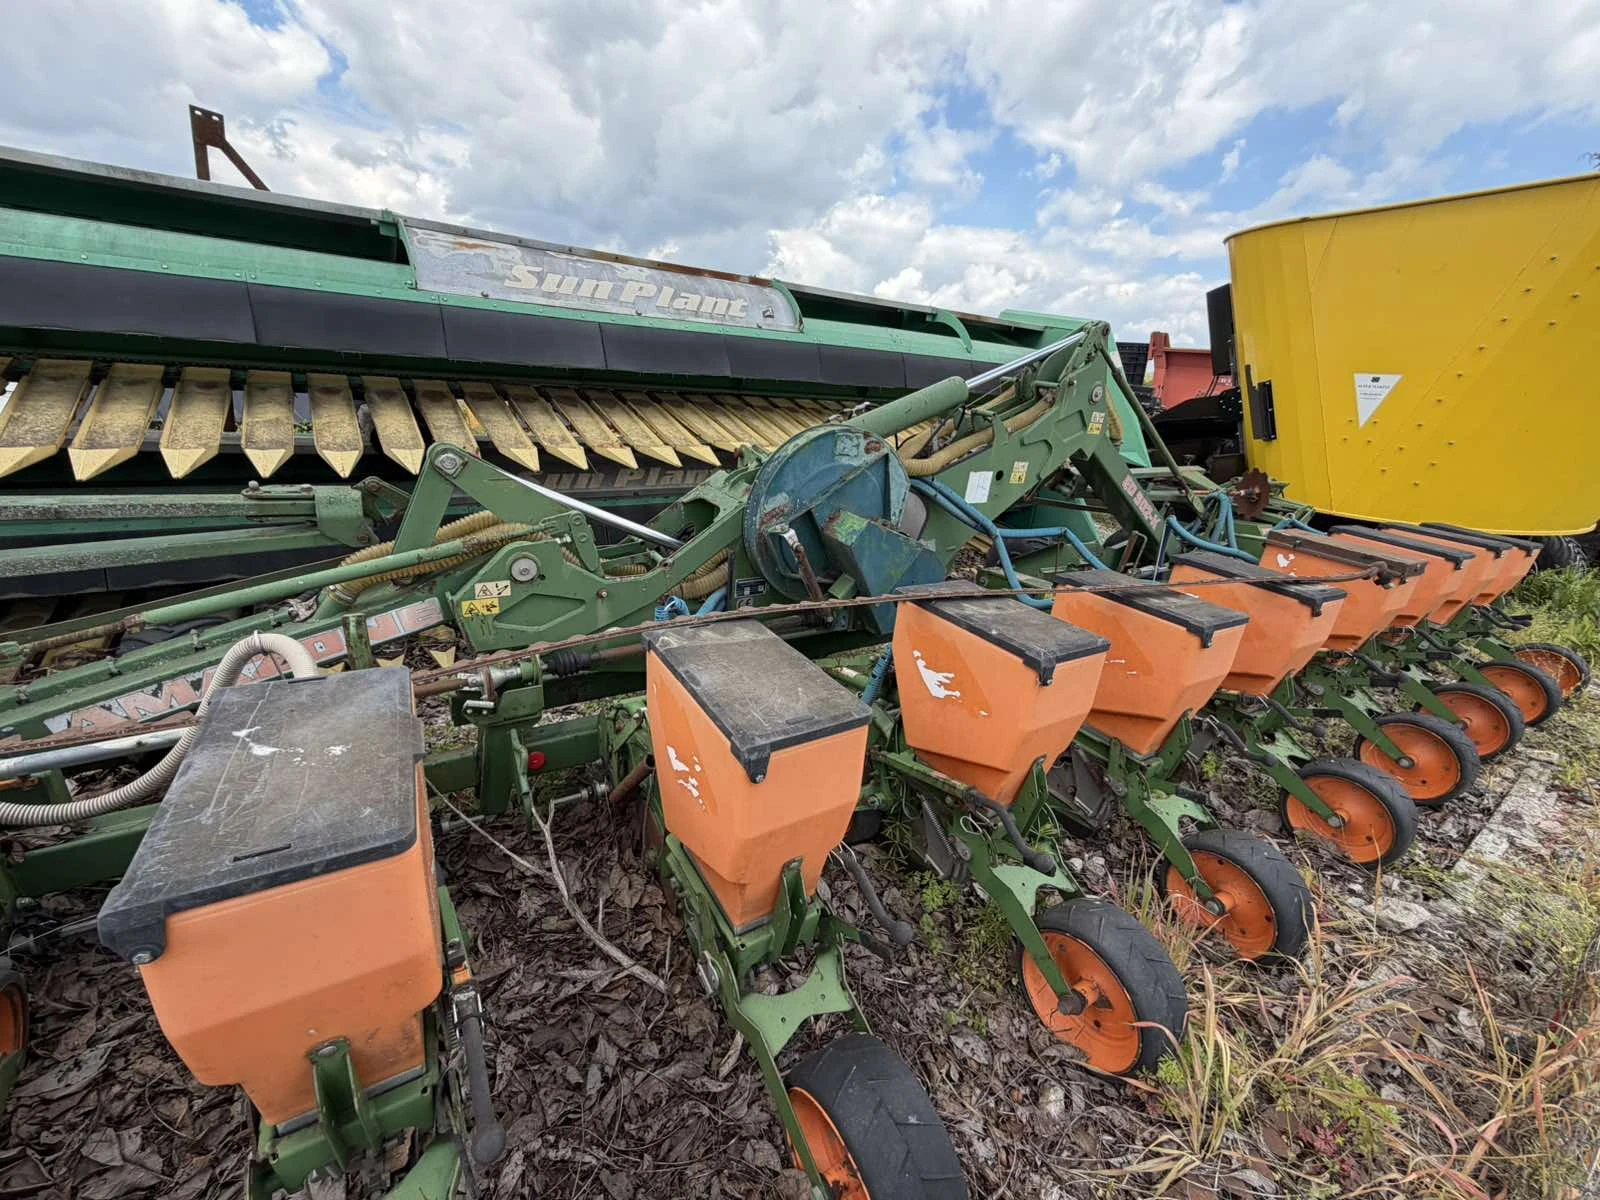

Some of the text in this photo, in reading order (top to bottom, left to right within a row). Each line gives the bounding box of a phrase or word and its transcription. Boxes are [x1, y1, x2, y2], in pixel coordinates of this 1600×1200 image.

[503, 265, 747, 317] Sun Plant
[614, 466, 714, 489] Plan
